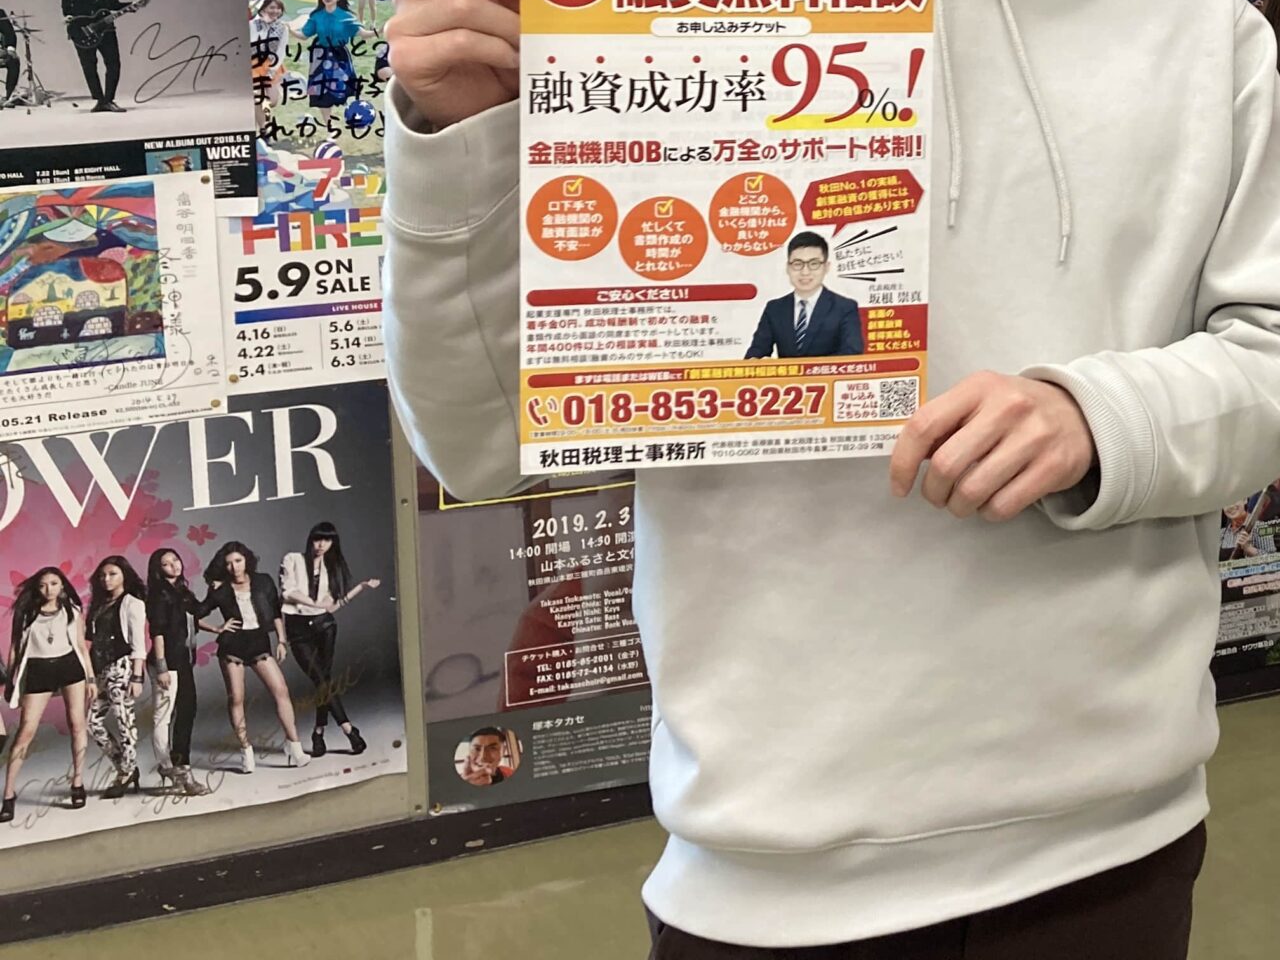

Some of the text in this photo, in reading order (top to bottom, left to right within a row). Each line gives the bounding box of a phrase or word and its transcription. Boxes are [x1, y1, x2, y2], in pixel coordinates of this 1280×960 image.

[676, 19, 787, 34] お申し込みチケット
[144, 137, 212, 150] NEW ALBUM OUT
[206, 144, 251, 160] WOKE
[548, 199, 597, 212] 口下手で
[737, 194, 769, 205] どこの
[541, 213, 604, 226] 金融機関の
[718, 217, 787, 229] いくら借りれば
[641, 220, 686, 233] 忙しくて
[634, 233, 694, 246] 書類作成の
[737, 229, 769, 240] 良いか
[645, 247, 682, 259] 時間が
[835, 245, 873, 261] 私たちに
[234, 259, 353, 303] 5.9 ON
[316, 276, 371, 295] SALE
[332, 302, 378, 312] LIVE HOUSE
[329, 320, 354, 333] 5.6
[236, 328, 271, 342] 4.16
[330, 336, 362, 351] 5.14
[237, 345, 275, 360] 4.22
[331, 354, 356, 368] 6.3
[239, 364, 265, 378] 5.4
[846, 382, 870, 391] WEB
[840, 392, 875, 402] 申し込み
[562, 385, 827, 426] 018-853-8227
[836, 400, 878, 410] フォームは
[48, 407, 108, 423] Release
[836, 409, 878, 419] こちらから
[539, 441, 706, 469] 秋田税理士事務所
[509, 540, 571, 560] 14:00 開場
